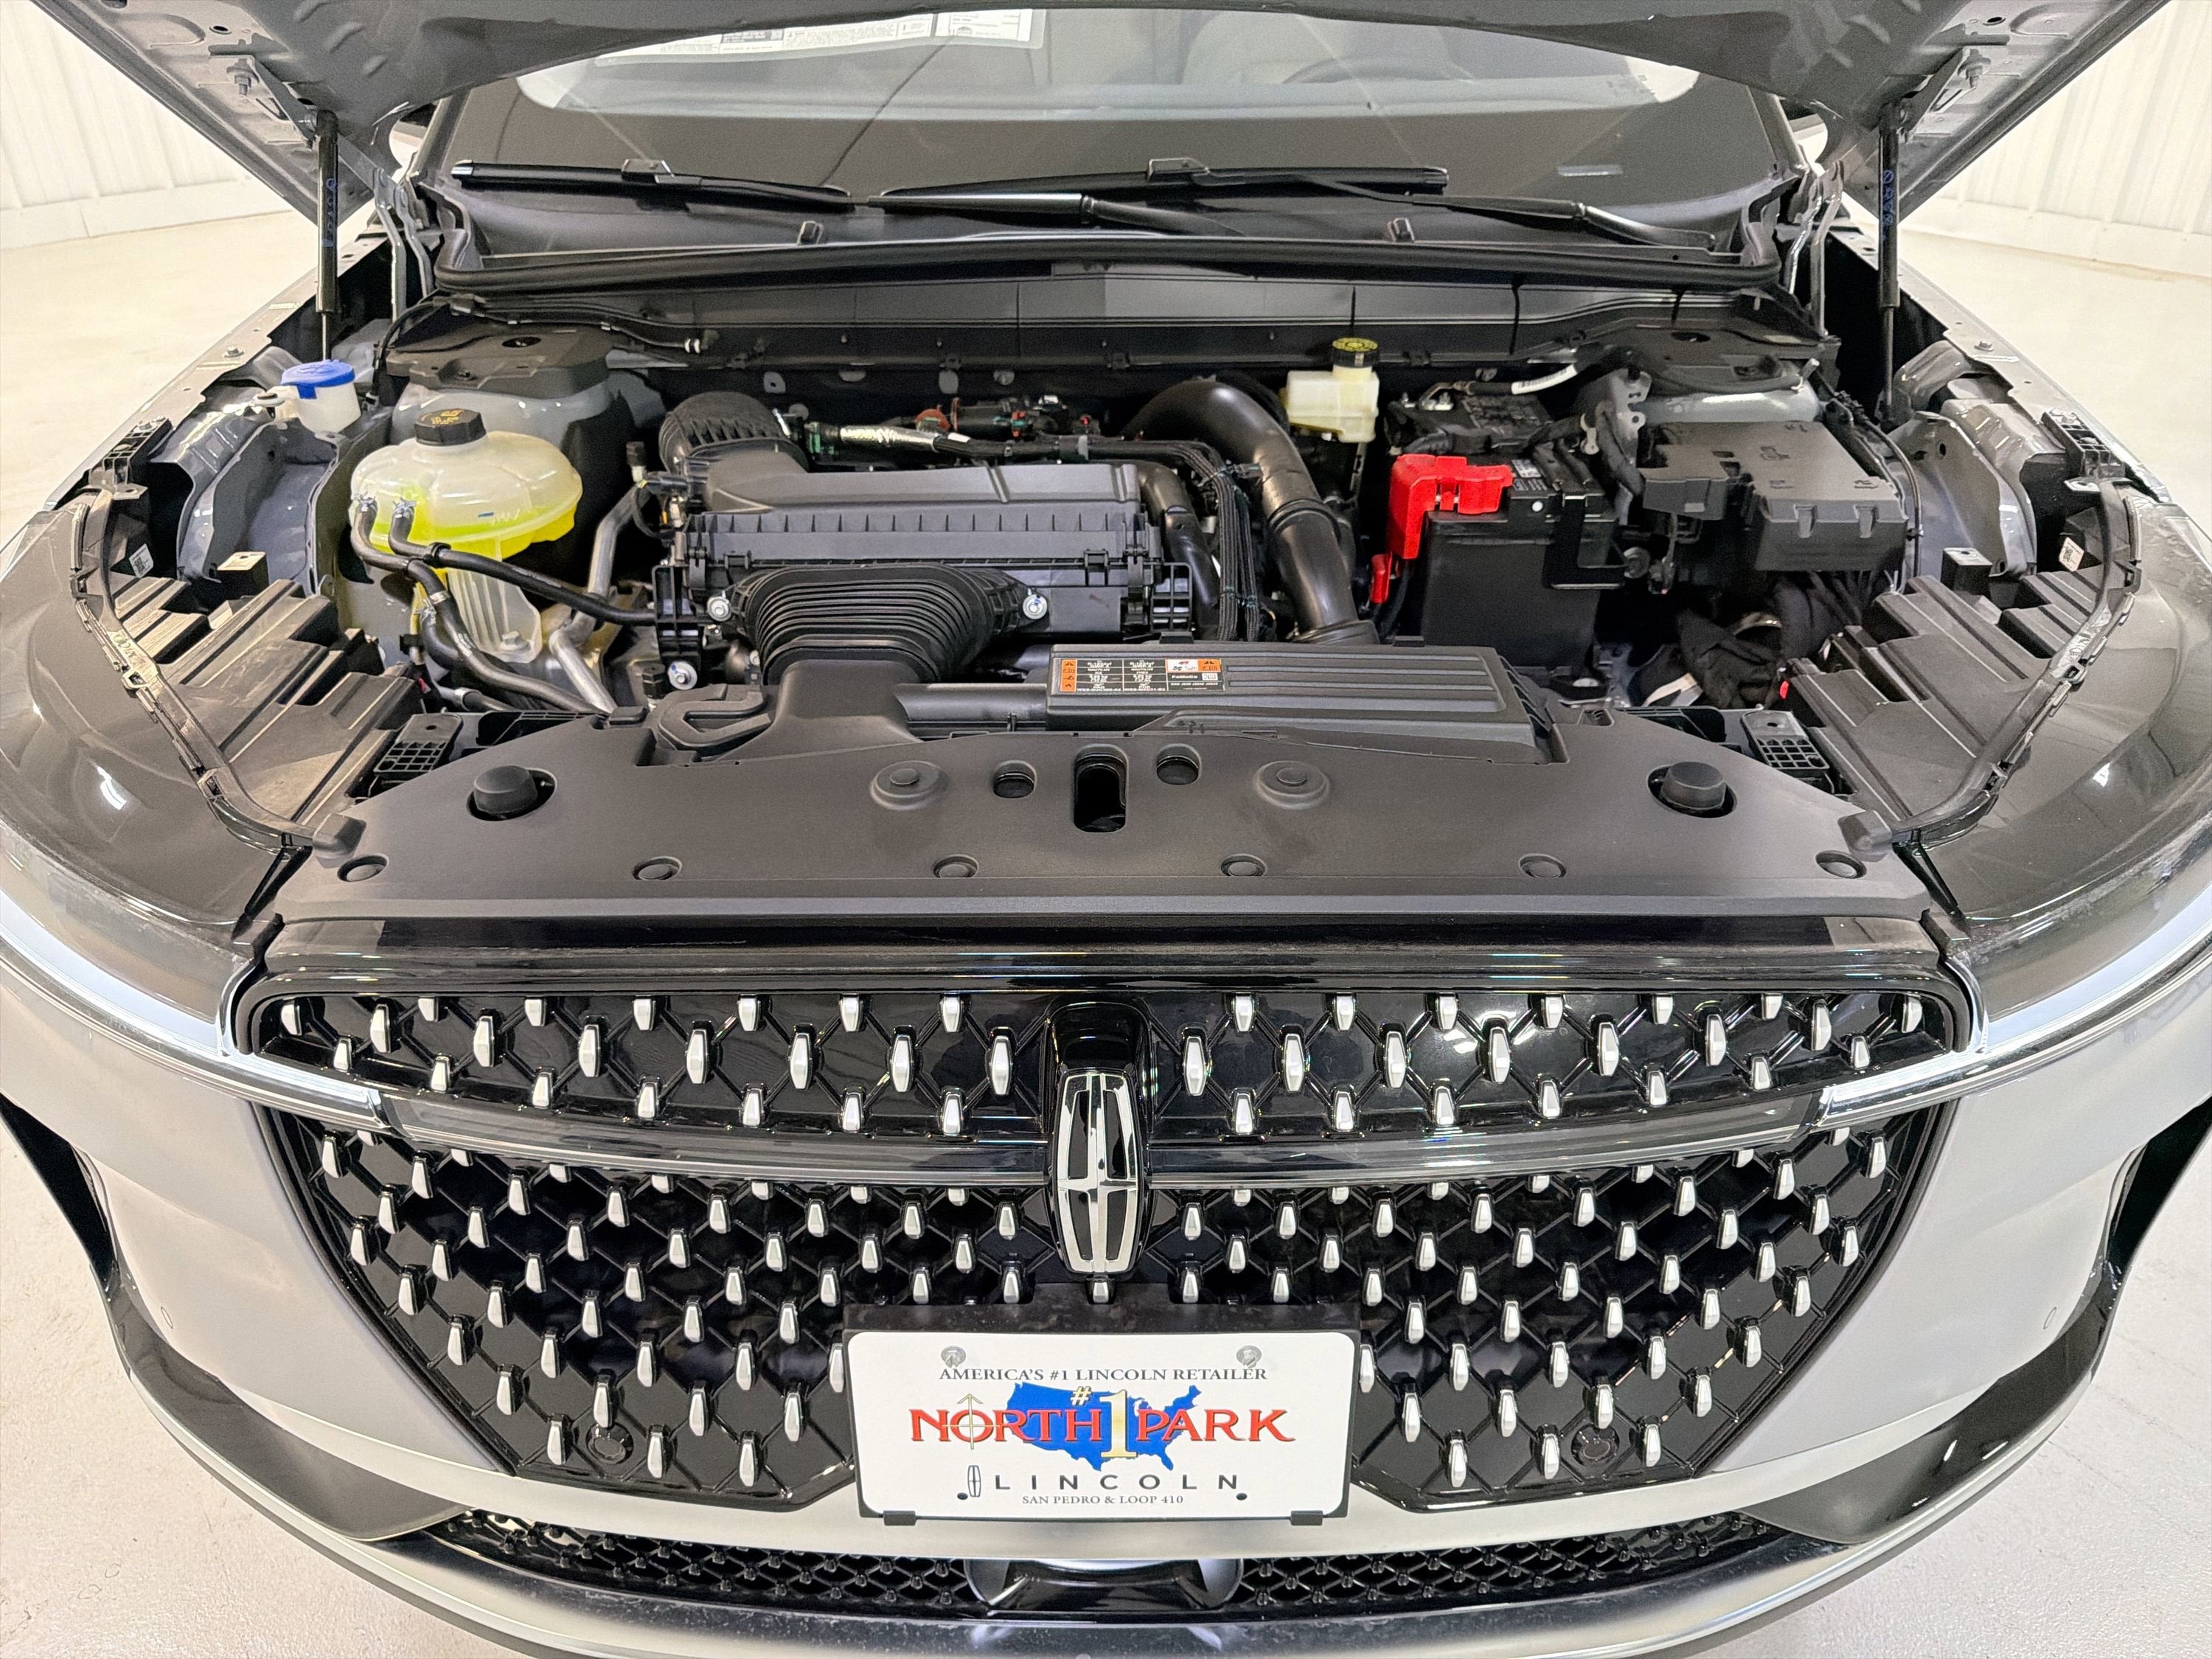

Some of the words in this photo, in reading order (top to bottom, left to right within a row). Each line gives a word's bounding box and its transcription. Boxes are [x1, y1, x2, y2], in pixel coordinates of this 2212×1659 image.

[939, 1368, 1044, 1381] AMERICA'S
[1050, 1369, 1069, 1380] #1
[1076, 1368, 1166, 1380] LINCOLN
[1173, 1368, 1267, 1380] RETAILER
[908, 1408, 1104, 1442] NORTH
[1136, 1409, 1295, 1441] PARK
[995, 1474, 1238, 1490] LINCOLN
[1022, 1495, 1048, 1504] SAN
[1054, 1495, 1100, 1504] PEDRO
[1105, 1495, 1115, 1504] &
[1119, 1495, 1157, 1504] LOOP
[1161, 1495, 1183, 1504] 410
